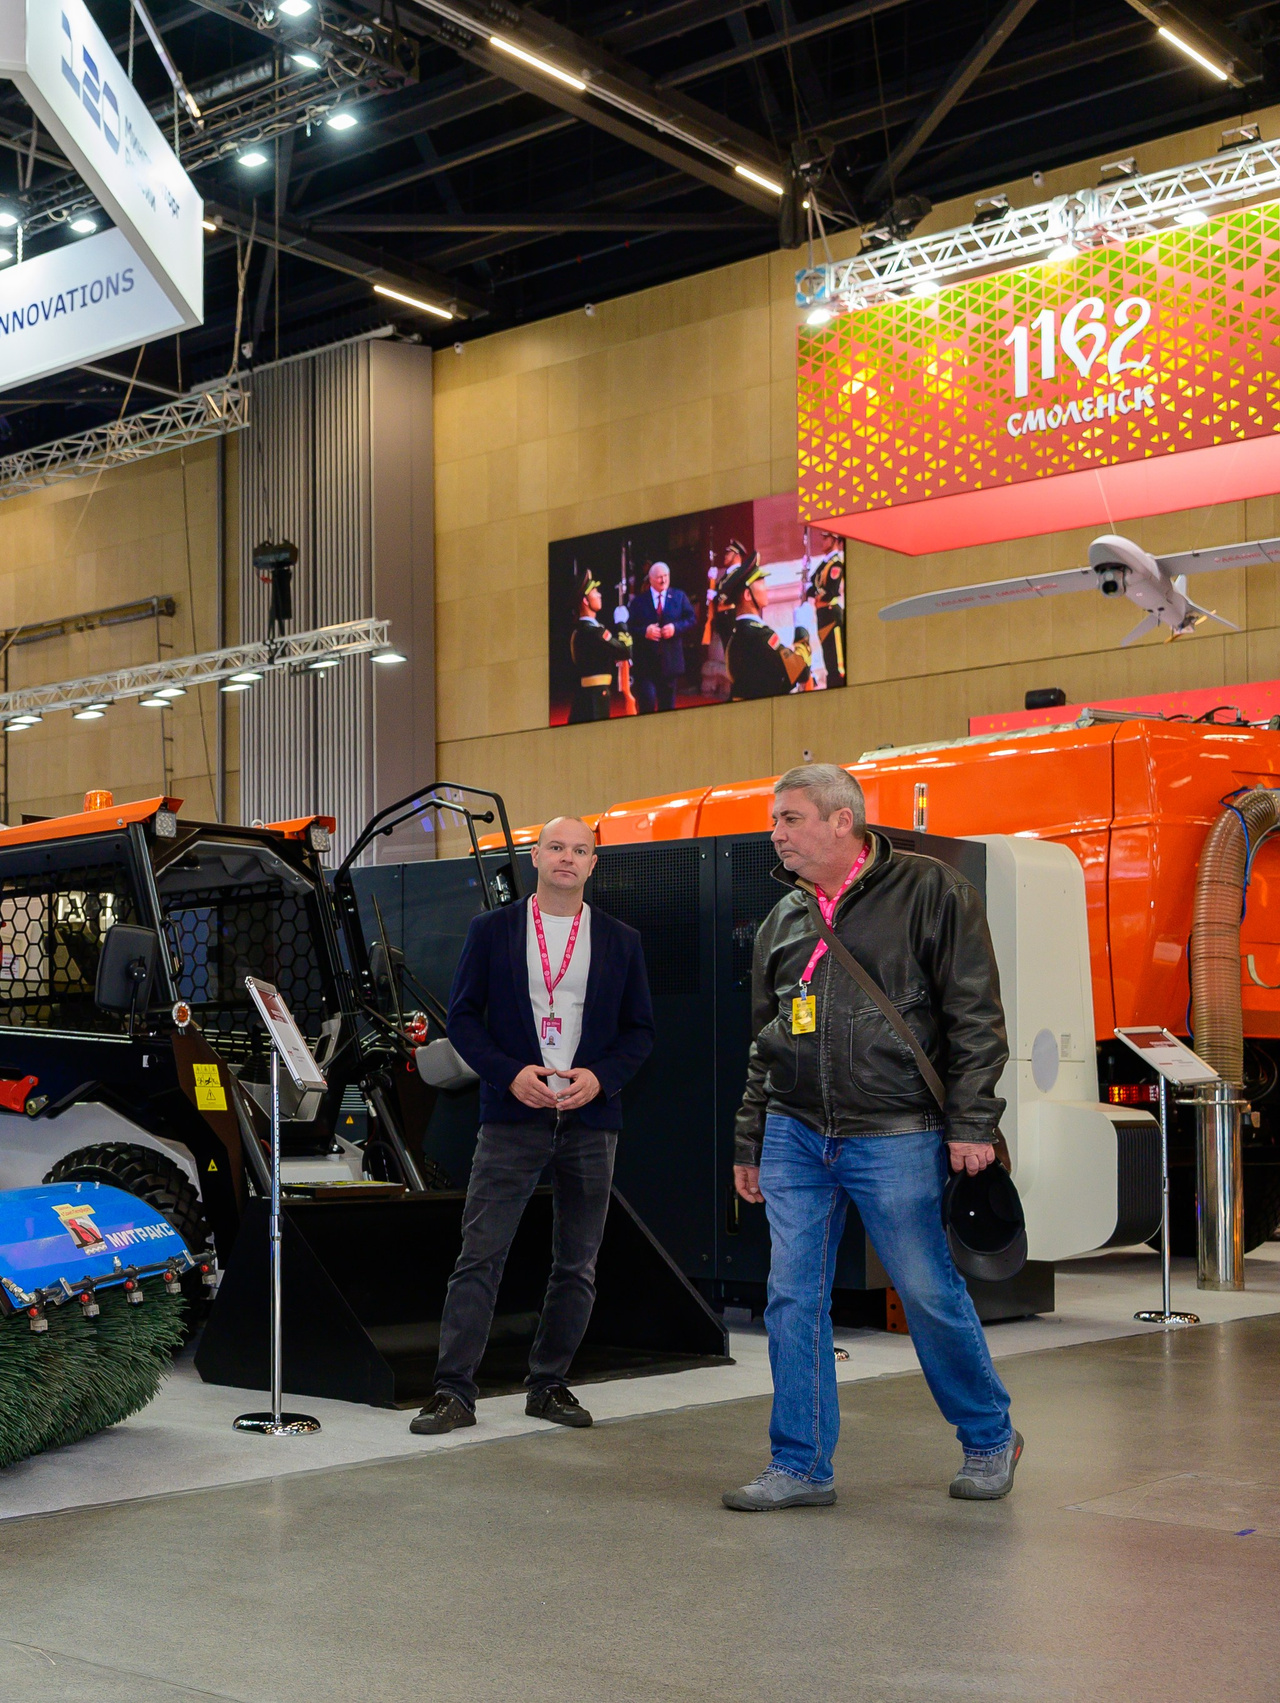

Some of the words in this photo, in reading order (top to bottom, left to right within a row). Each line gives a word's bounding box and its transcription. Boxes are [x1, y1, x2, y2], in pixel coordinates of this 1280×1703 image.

[1004, 296, 1151, 398] 1162
[1006, 384, 1155, 437] СМОЛЕНСК
[104, 1222, 176, 1248] МИТРАКС
